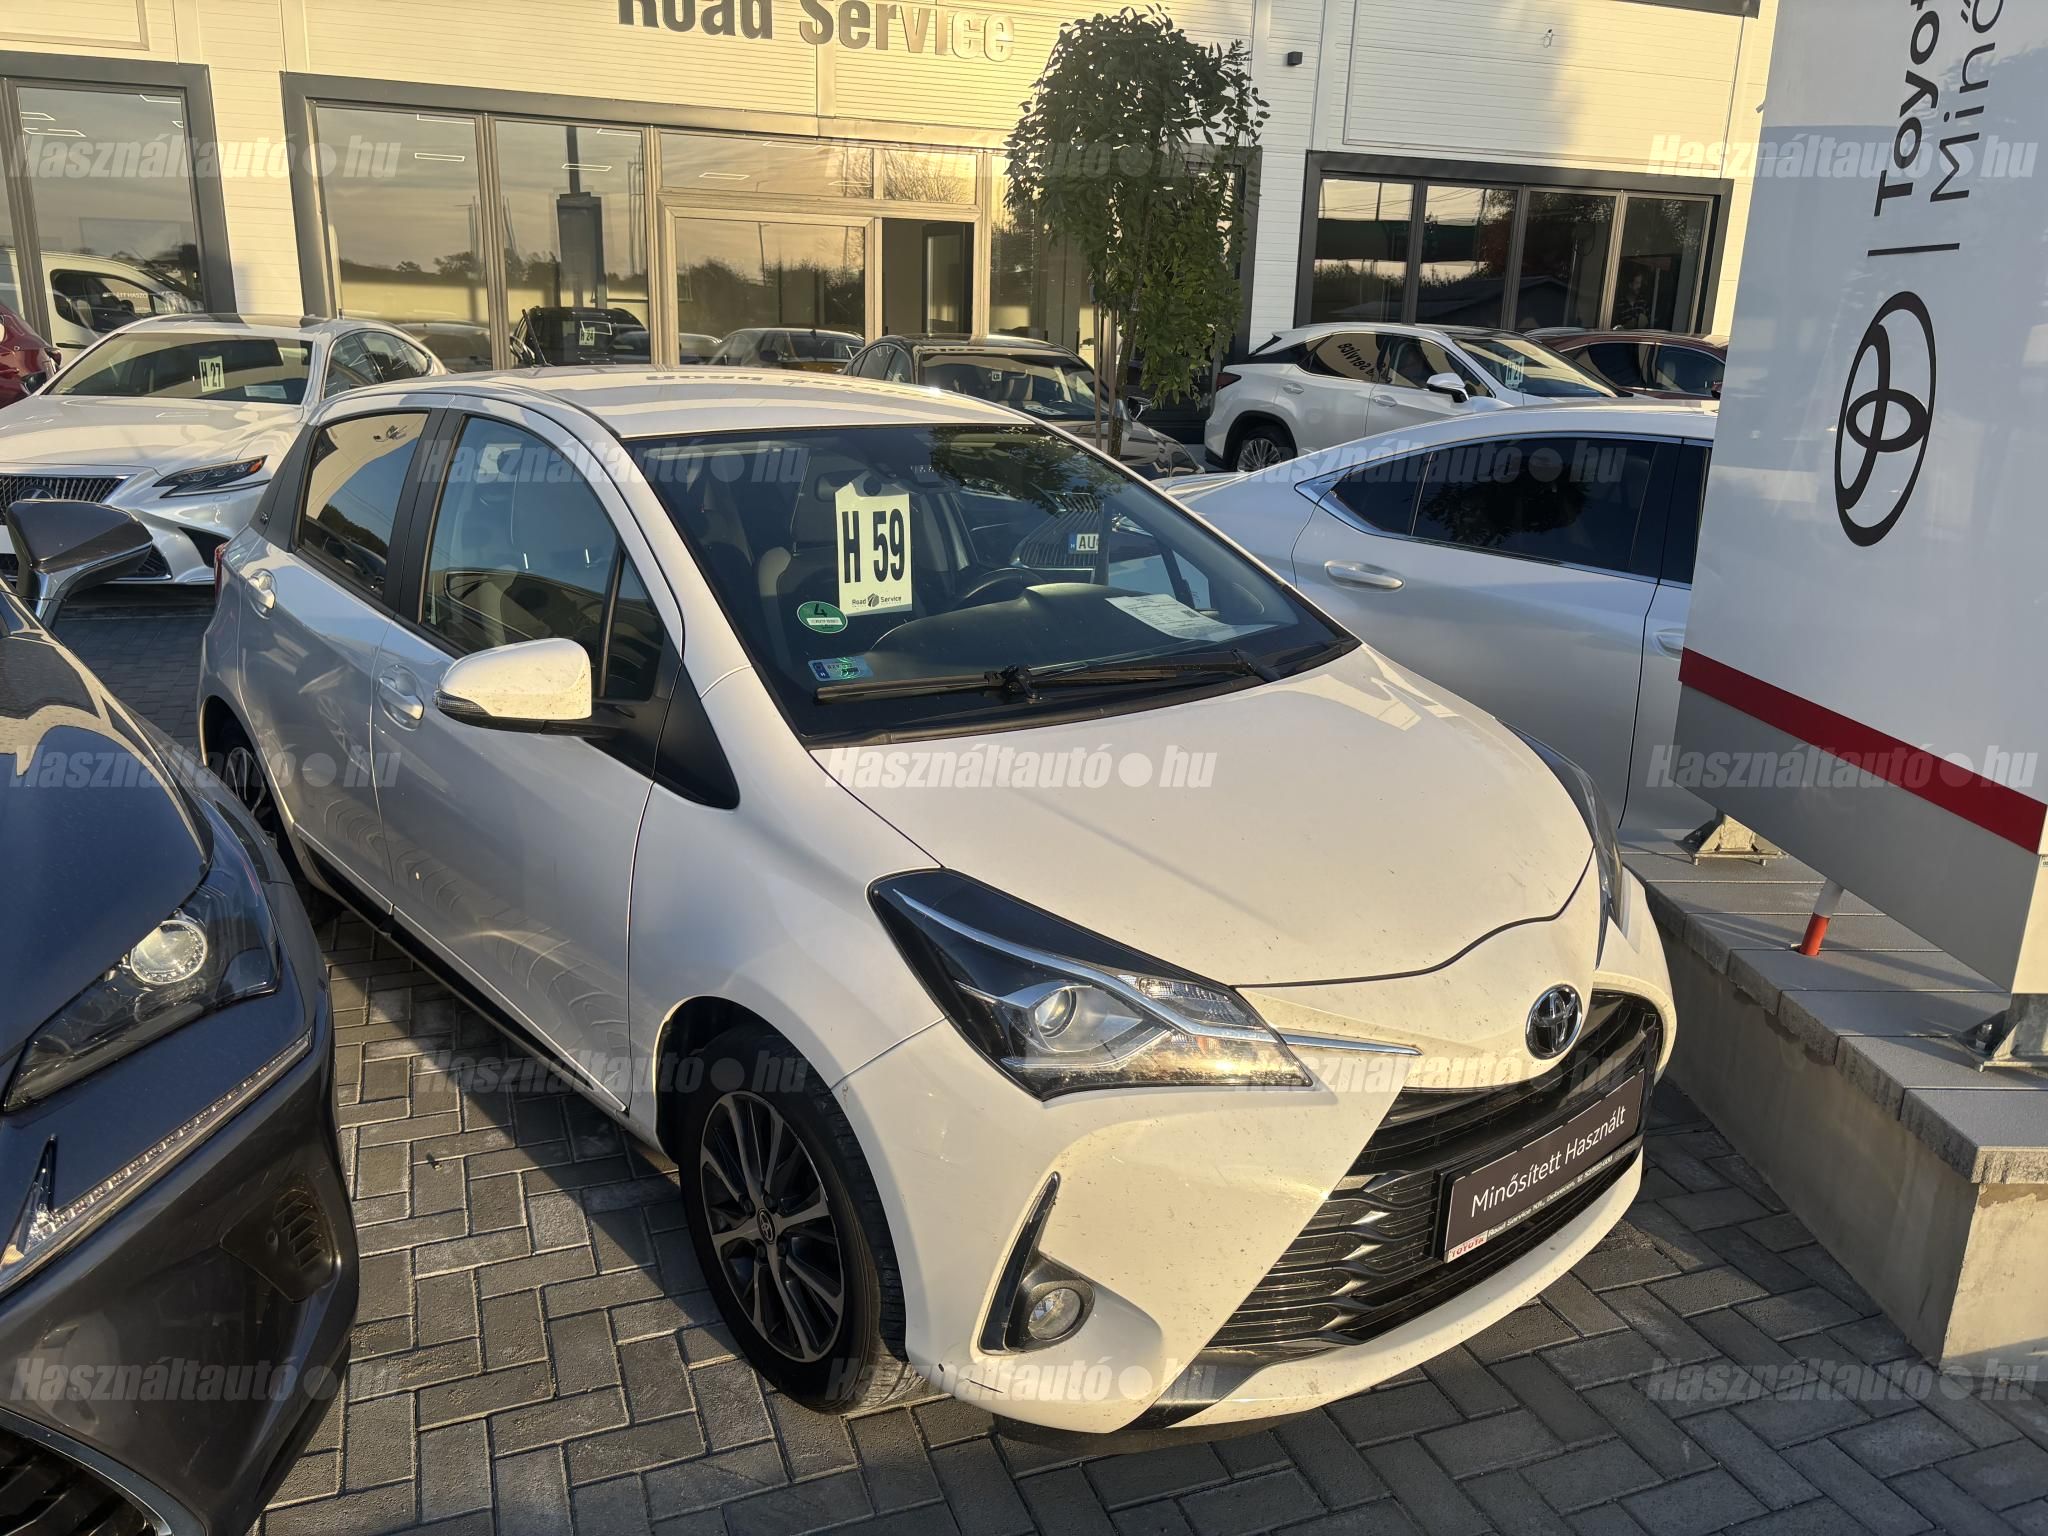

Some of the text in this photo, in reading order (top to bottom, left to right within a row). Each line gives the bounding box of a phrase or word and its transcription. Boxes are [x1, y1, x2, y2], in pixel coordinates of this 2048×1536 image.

[799, 0, 1015, 62] Service
[201, 361, 221, 388] H 27
[842, 508, 905, 584] H 59
[1471, 1105, 1626, 1218] Minősített Használt
